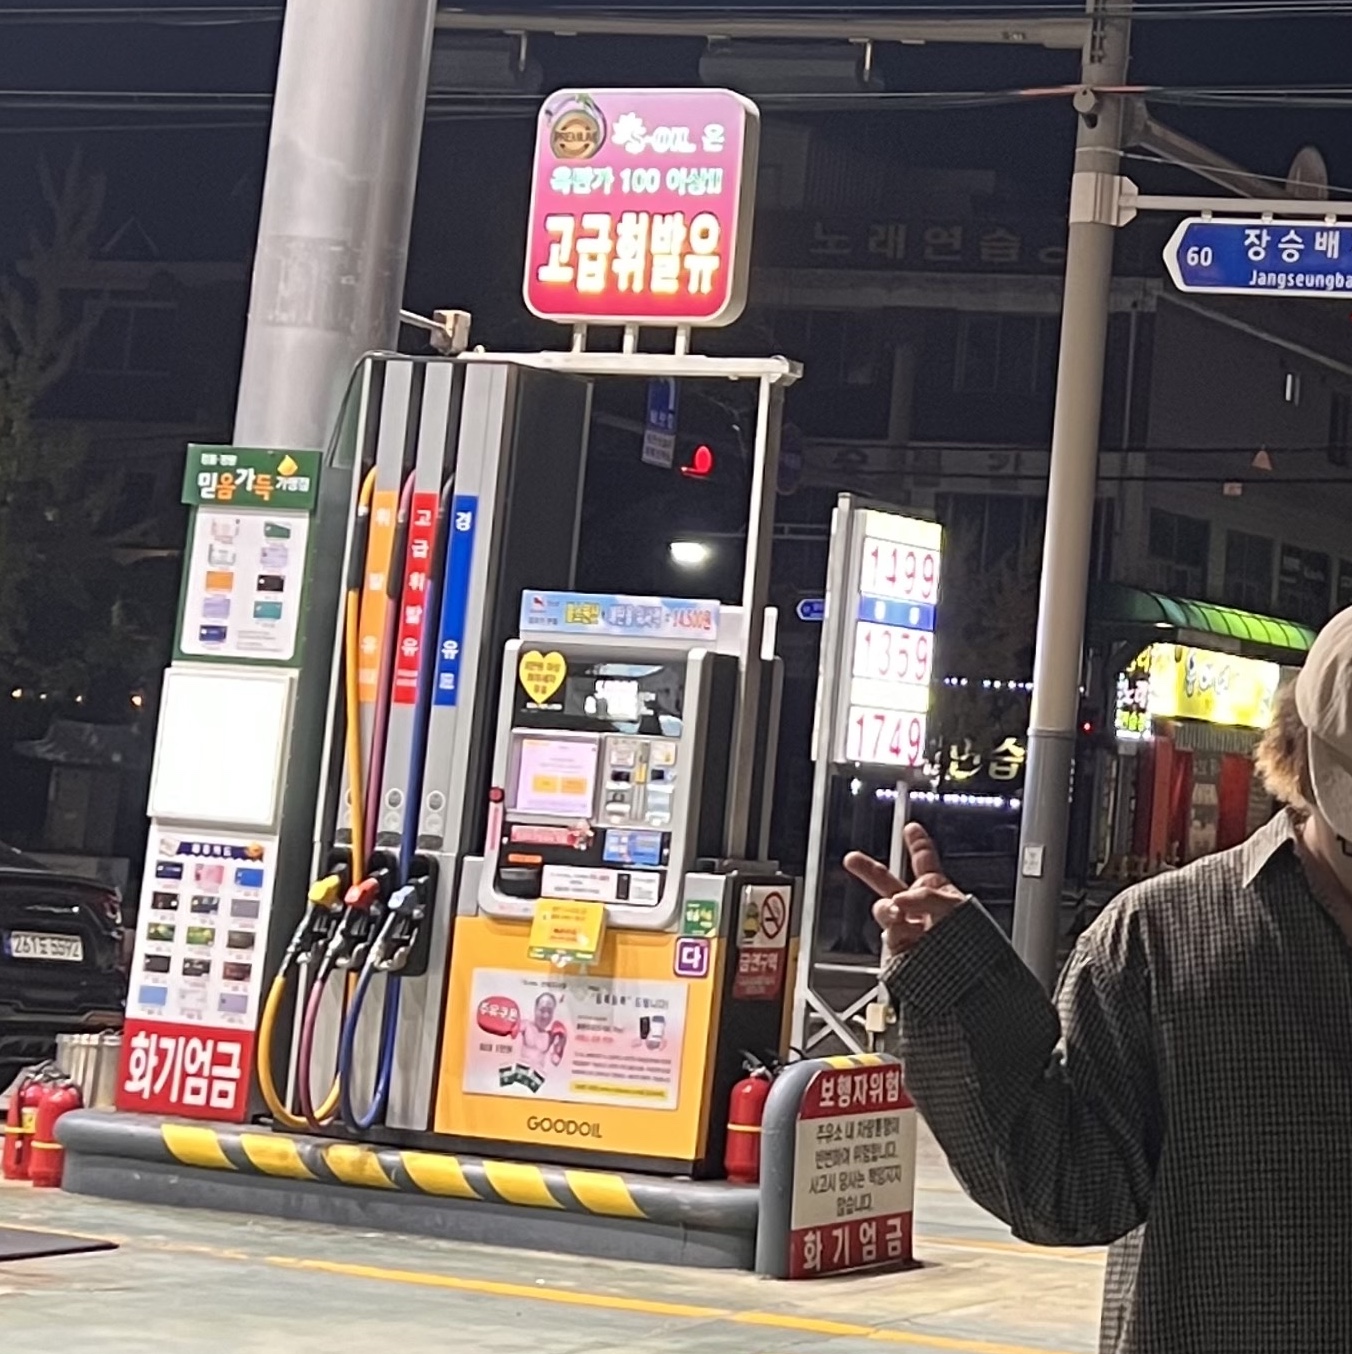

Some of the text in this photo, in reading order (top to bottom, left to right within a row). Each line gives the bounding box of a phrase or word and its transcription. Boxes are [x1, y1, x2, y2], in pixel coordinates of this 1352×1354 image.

[702, 123, 725, 152] 은
[620, 167, 661, 194] 100
[537, 211, 722, 295] 고급휘발유
[808, 220, 1065, 265] 노래연습
[1186, 246, 1213, 268] 60
[197, 467, 274, 501] 믿음가득
[441, 511, 473, 660] 경유
[864, 629, 928, 682] 1359
[855, 713, 922, 766] 1749
[124, 1029, 242, 1109] 화기엄금
[819, 1069, 900, 1108] 보행자위험
[526, 1115, 603, 1139] GOODOIL
[816, 1123, 842, 1143] 주유소
[808, 1172, 837, 1194] 사고시
[802, 1217, 903, 1271] 화기엄금
